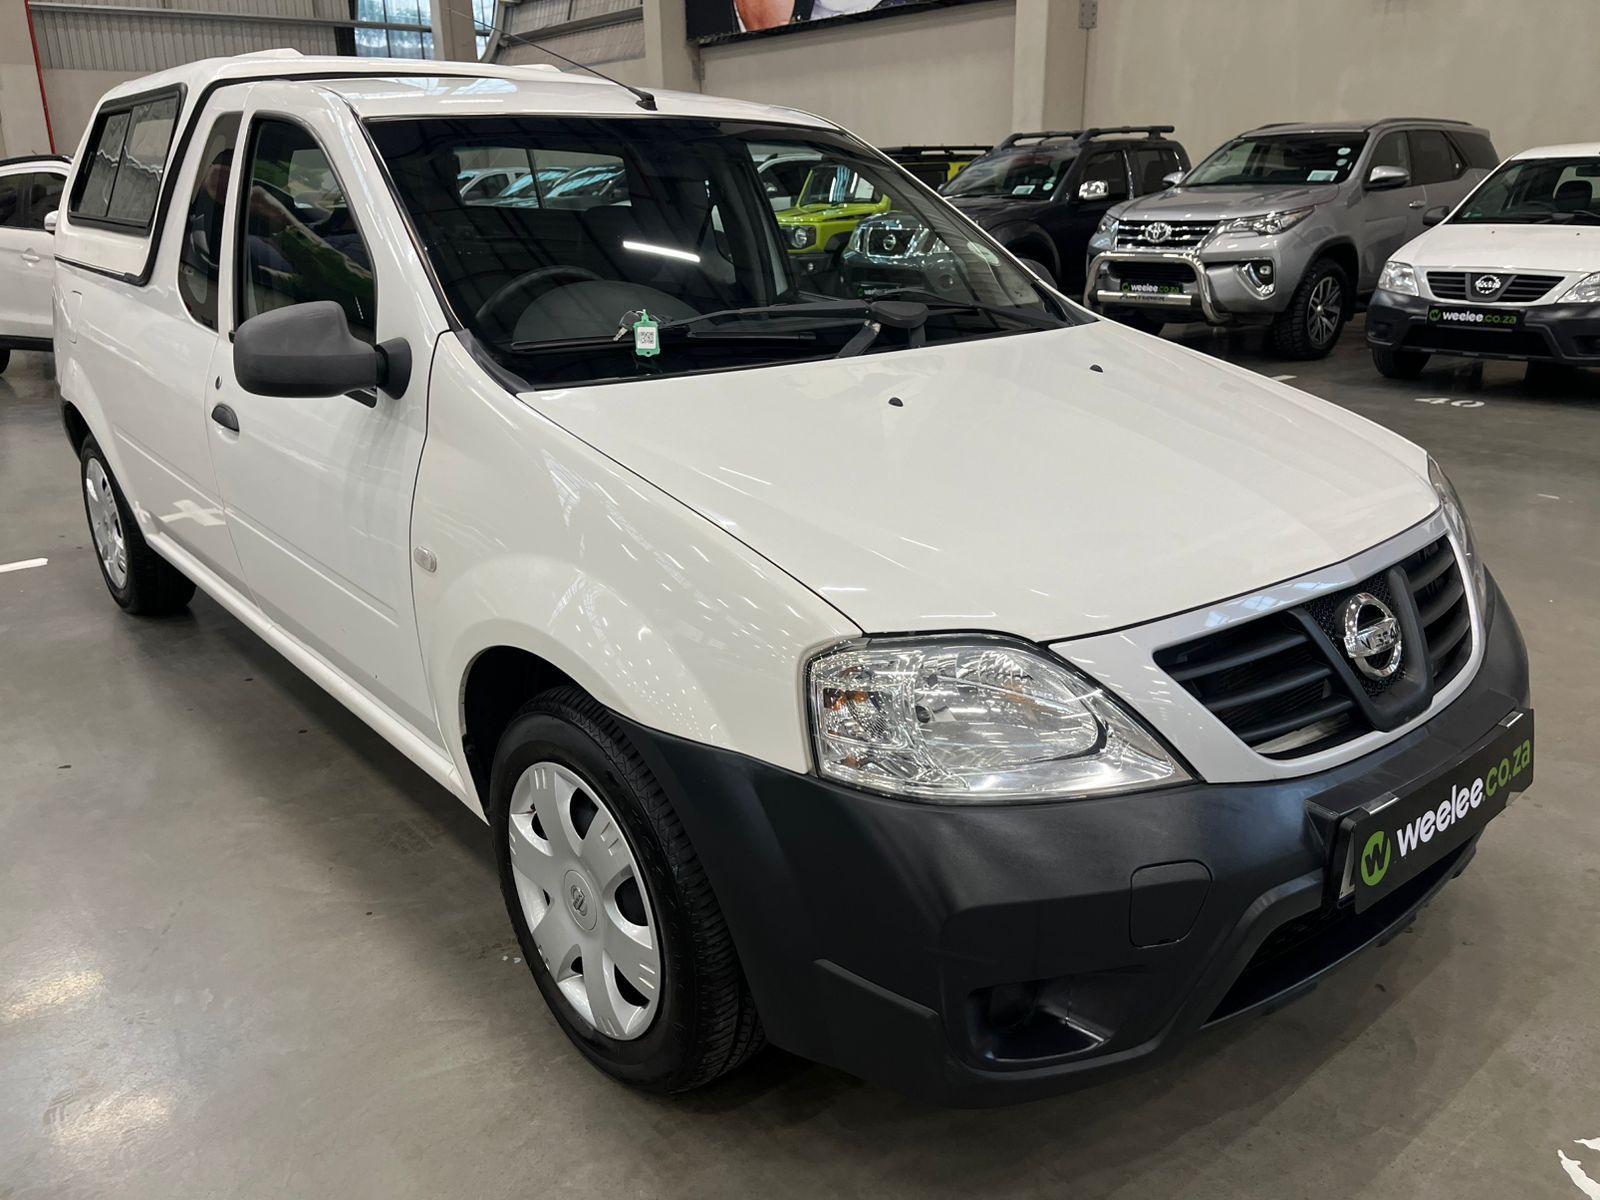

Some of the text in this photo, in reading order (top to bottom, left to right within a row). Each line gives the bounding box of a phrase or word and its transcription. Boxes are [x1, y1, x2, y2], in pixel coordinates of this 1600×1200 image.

[1443, 310, 1518, 324] weelee.co.za
[1414, 397, 1485, 408] 40
[1397, 739, 1531, 857] weelee.co.za
